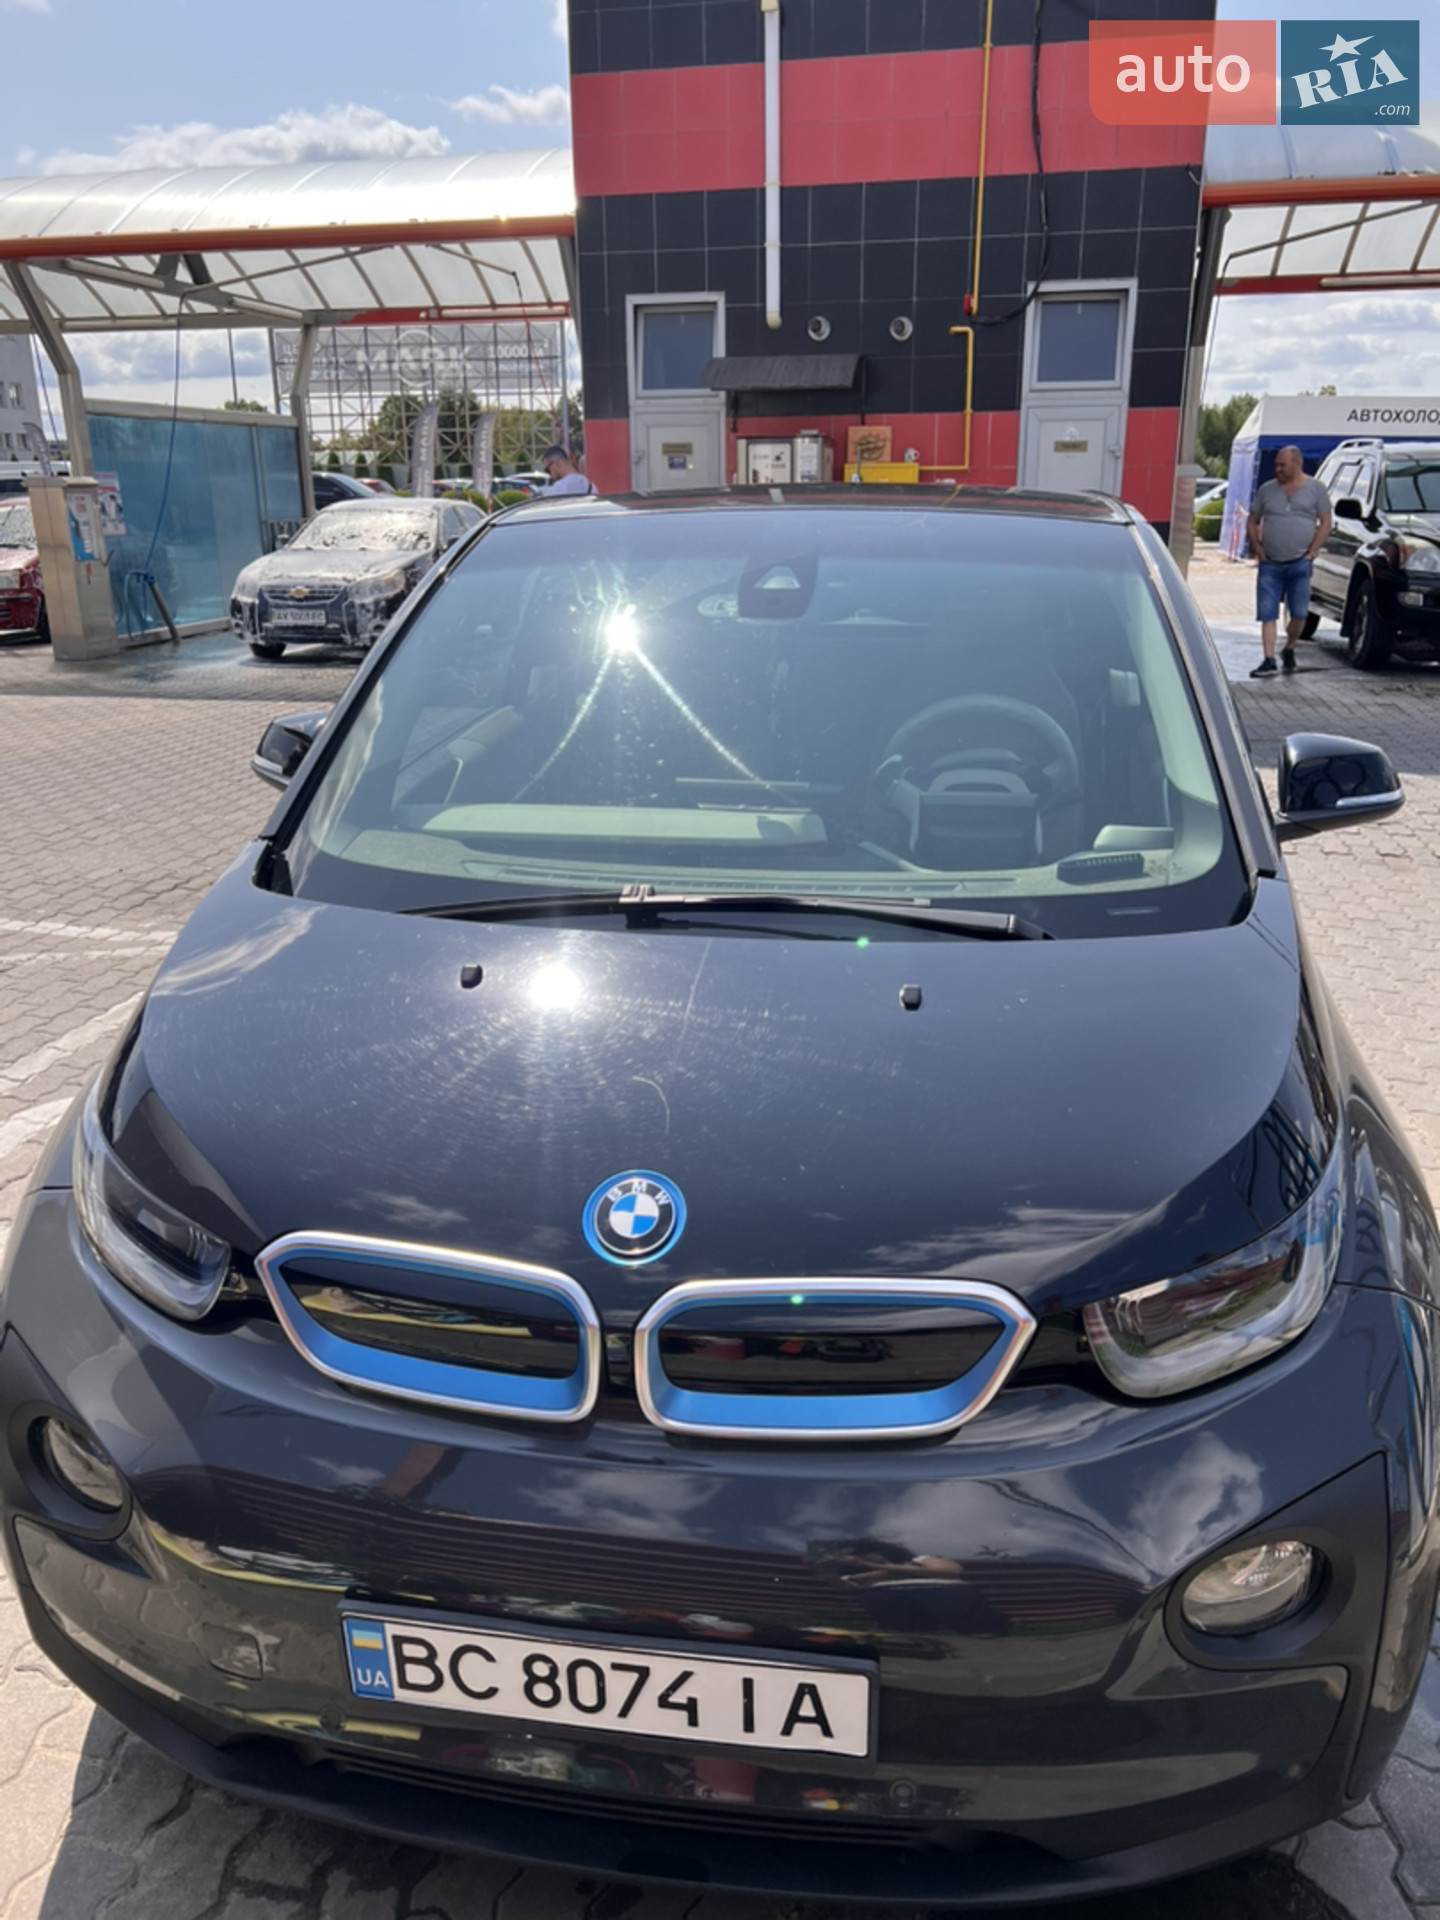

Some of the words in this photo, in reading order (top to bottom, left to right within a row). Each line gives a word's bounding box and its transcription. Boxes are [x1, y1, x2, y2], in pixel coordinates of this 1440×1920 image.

[1346, 407, 1440, 426] АВТОХОЛО
[606, 1180, 671, 1206] BMW
[356, 1667, 389, 1689] UA
[391, 1634, 499, 1700] BC
[521, 1653, 699, 1727] 8074
[742, 1677, 835, 1738] IA
